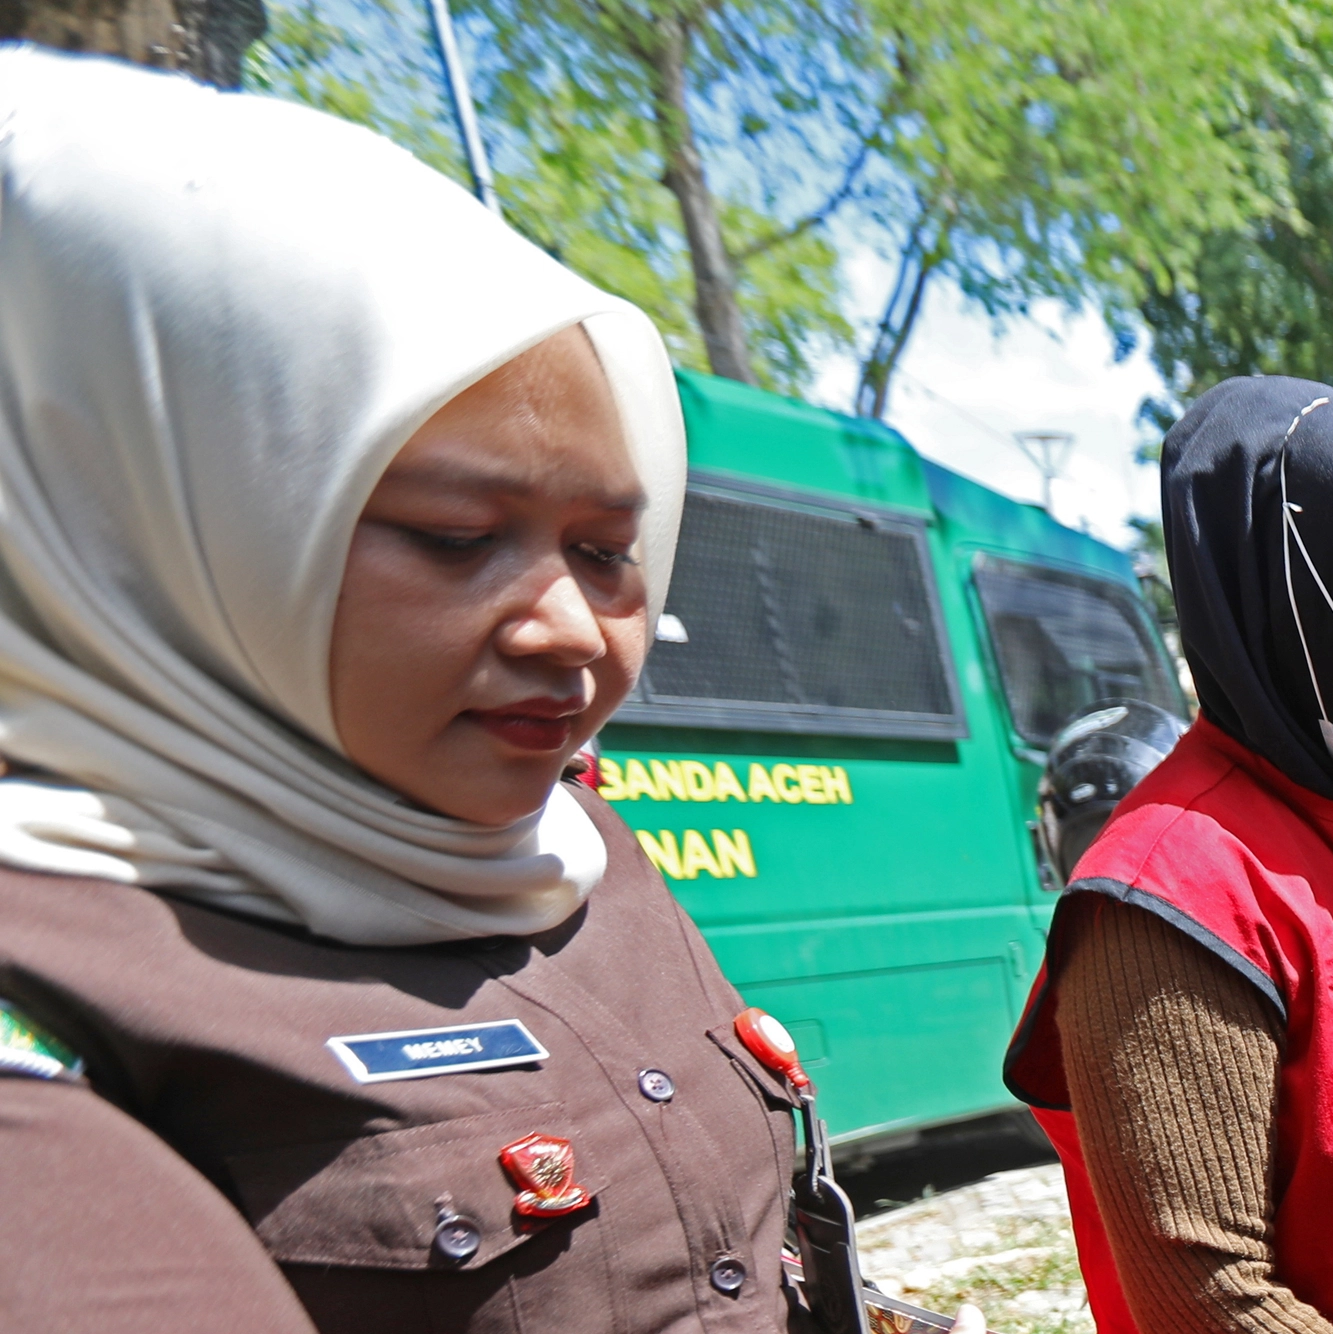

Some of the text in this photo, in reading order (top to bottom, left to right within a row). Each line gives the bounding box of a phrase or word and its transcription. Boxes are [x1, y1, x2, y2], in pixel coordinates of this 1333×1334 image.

[598, 758, 853, 804] BANDA ACEH
[402, 1036, 484, 1061] MEMEY
